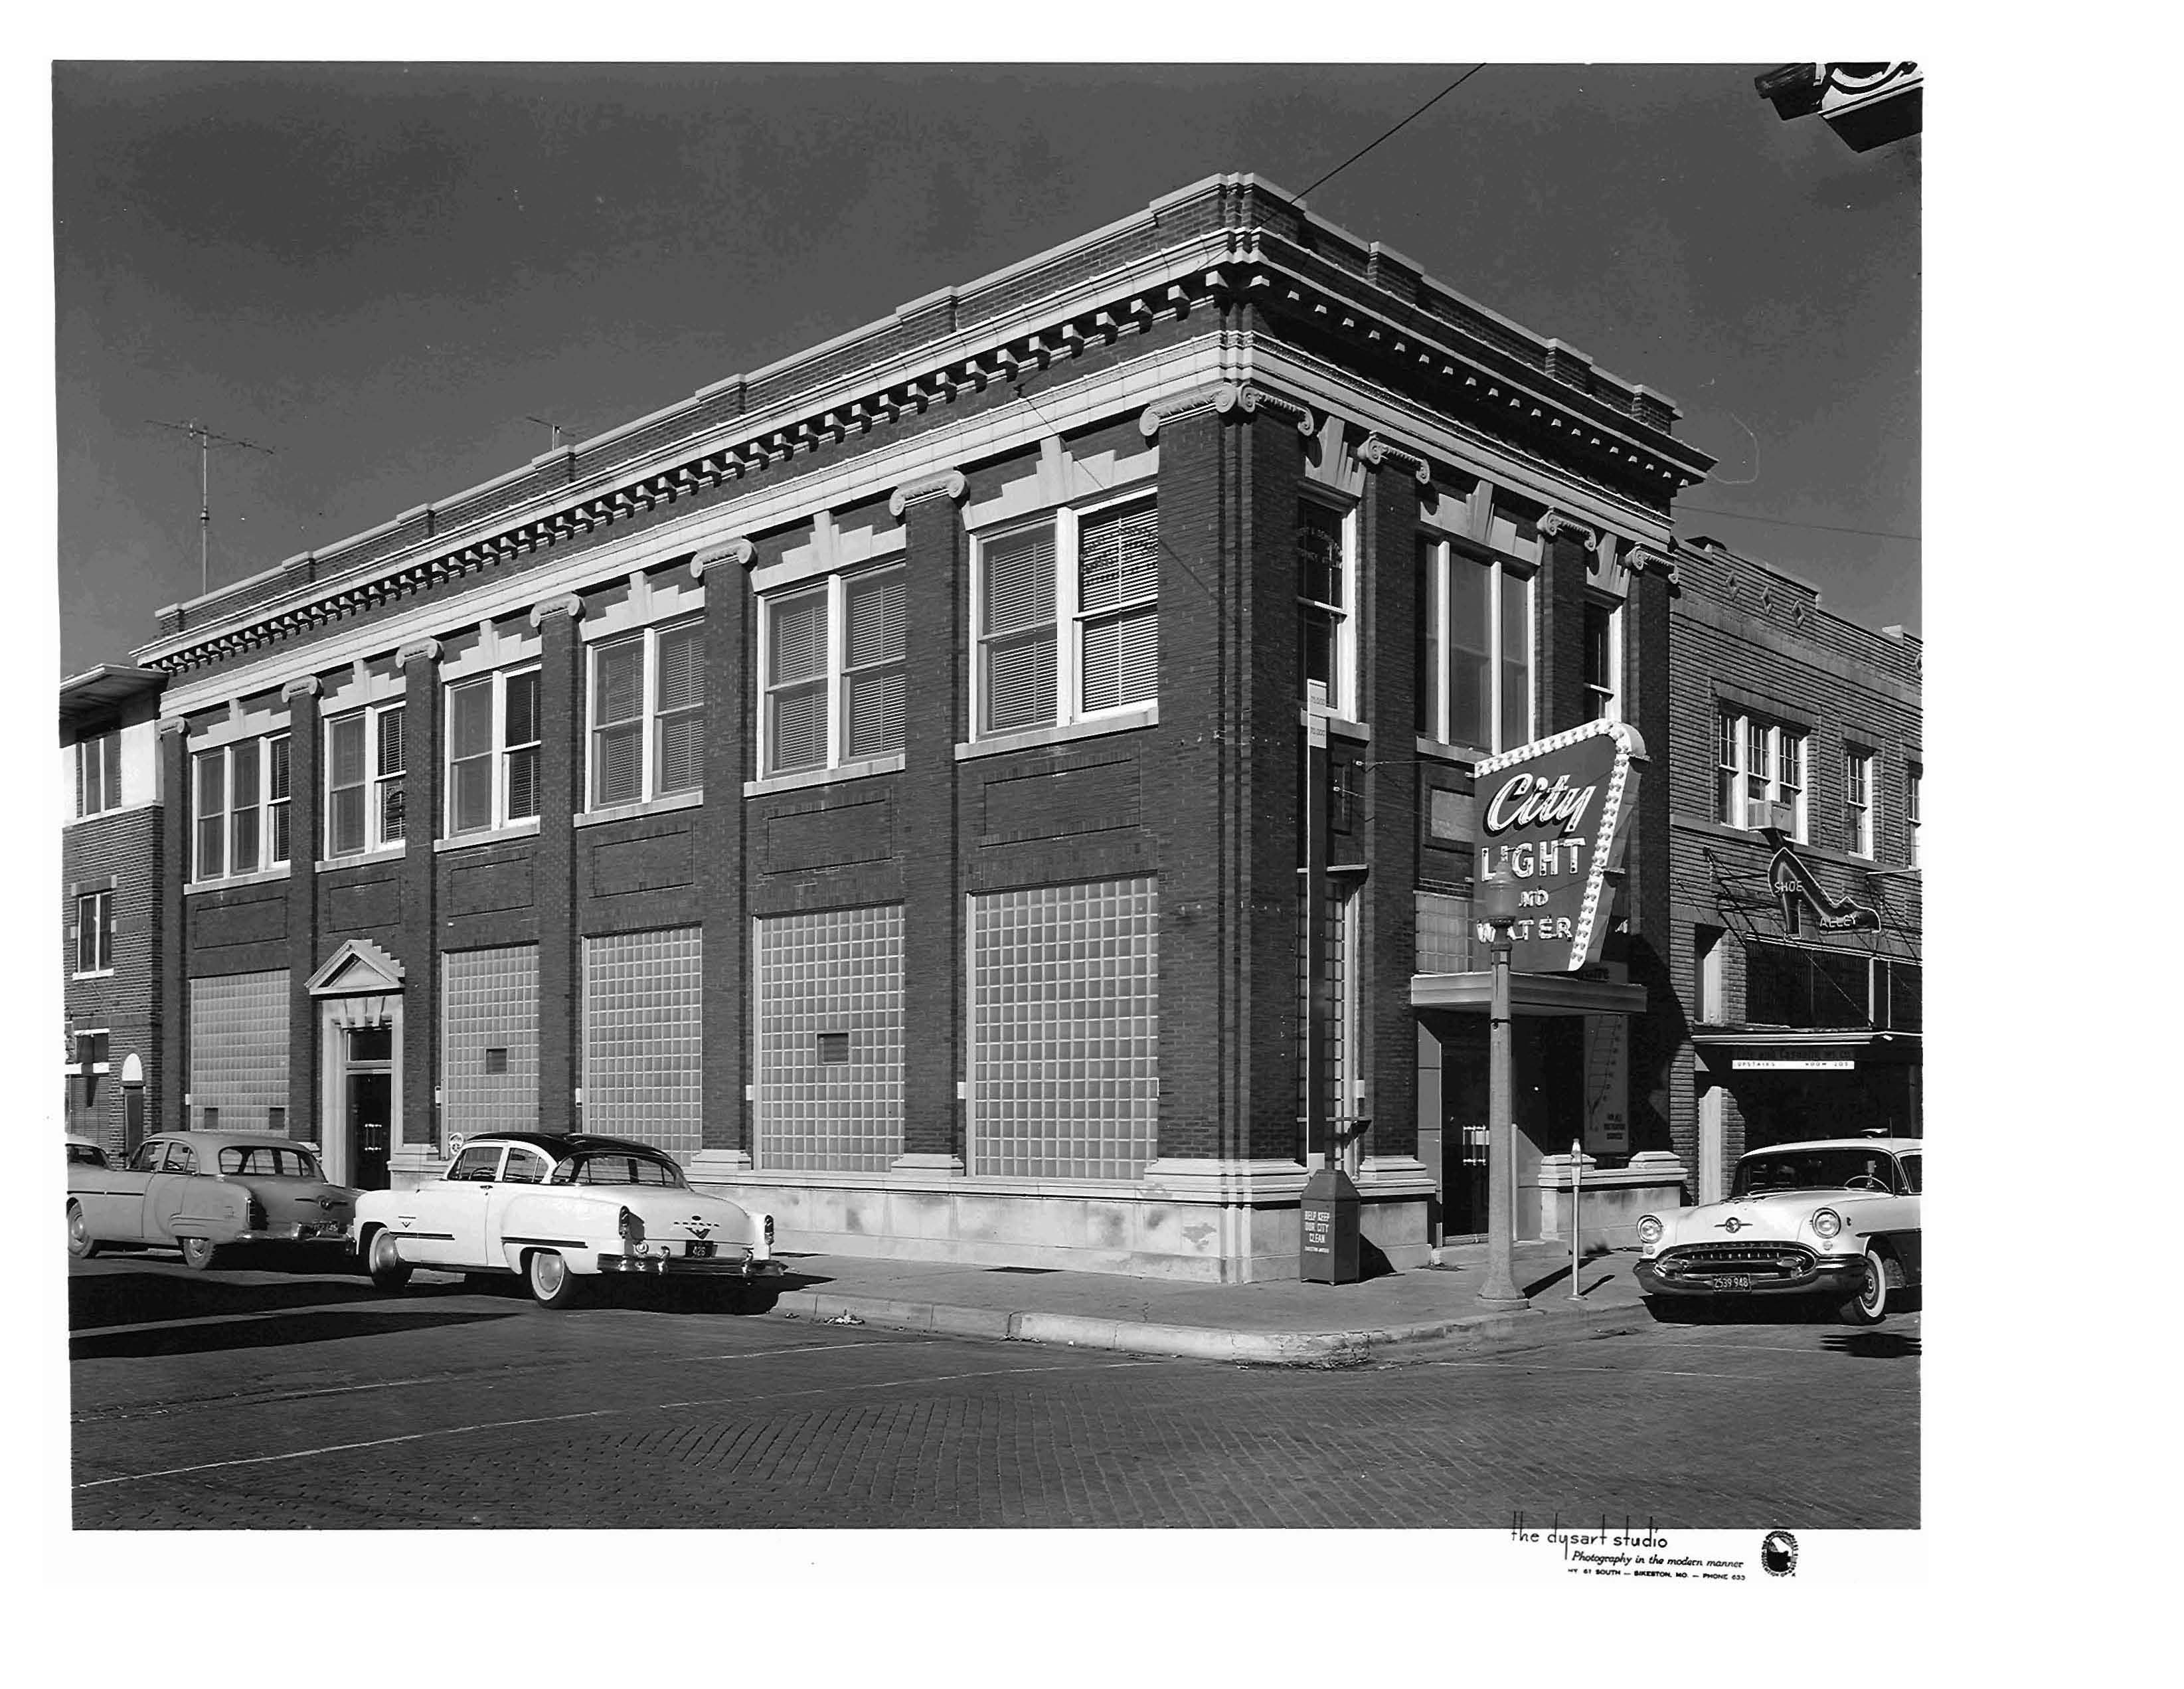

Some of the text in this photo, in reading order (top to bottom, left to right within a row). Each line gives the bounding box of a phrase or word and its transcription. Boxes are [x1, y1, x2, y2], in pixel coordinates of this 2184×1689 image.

[1485, 772, 1596, 835] City
[1774, 880, 1803, 893] SHOE
[1519, 889, 1549, 907] AND
[1819, 914, 1857, 928] ALLEY
[1304, 1210, 1330, 1222] HELP KEEP
[1317, 1223, 1329, 1233] CITY
[1309, 1233, 1325, 1243] CLEAN
[1713, 1278, 1732, 1288] 2539
